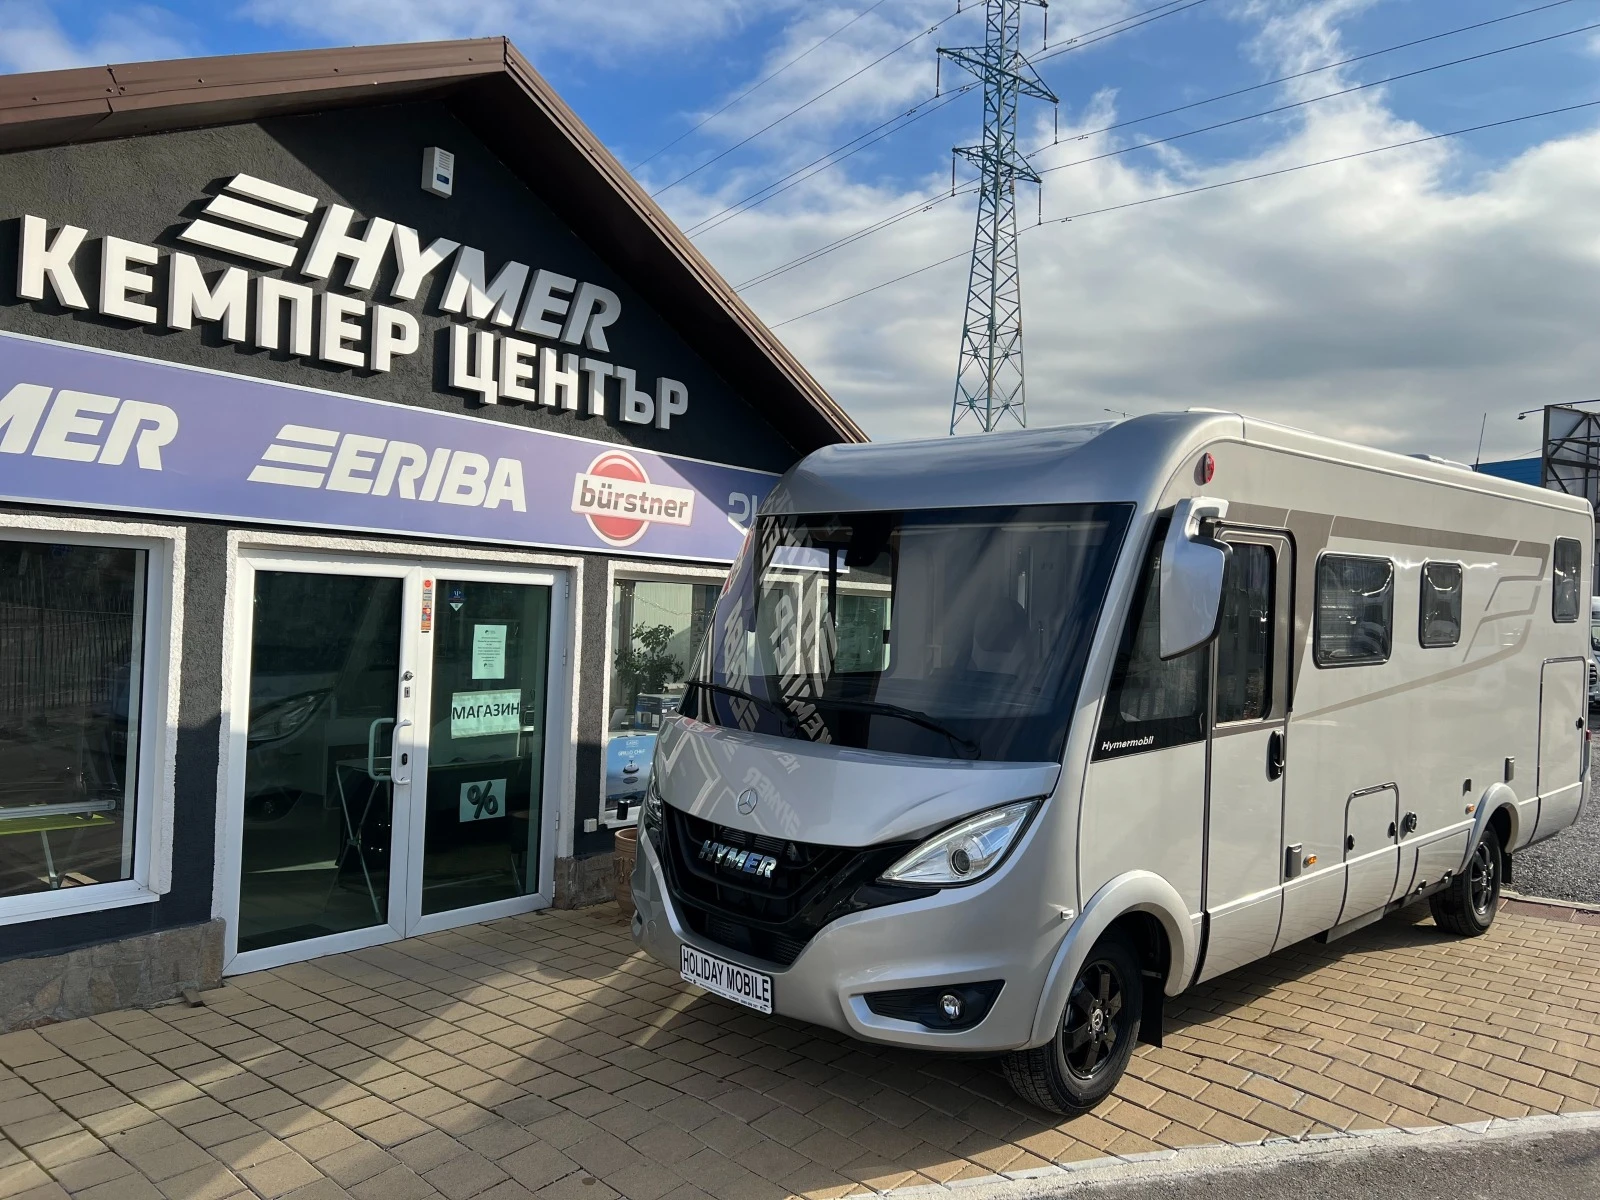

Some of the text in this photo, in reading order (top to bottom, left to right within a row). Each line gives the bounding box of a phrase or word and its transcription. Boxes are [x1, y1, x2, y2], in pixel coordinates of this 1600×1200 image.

[301, 203, 622, 353] HYMER
[16, 214, 689, 430] КЕМПЕР ЦЕНТЪР
[326, 441, 527, 513] ERIBA
[579, 473, 689, 520] bürstner
[452, 701, 520, 721] МАГАЗИН
[1101, 735, 1154, 751] Hymermobil
[698, 839, 777, 878] HYMER
[683, 948, 770, 1003] HOLIDAY MOBILE
